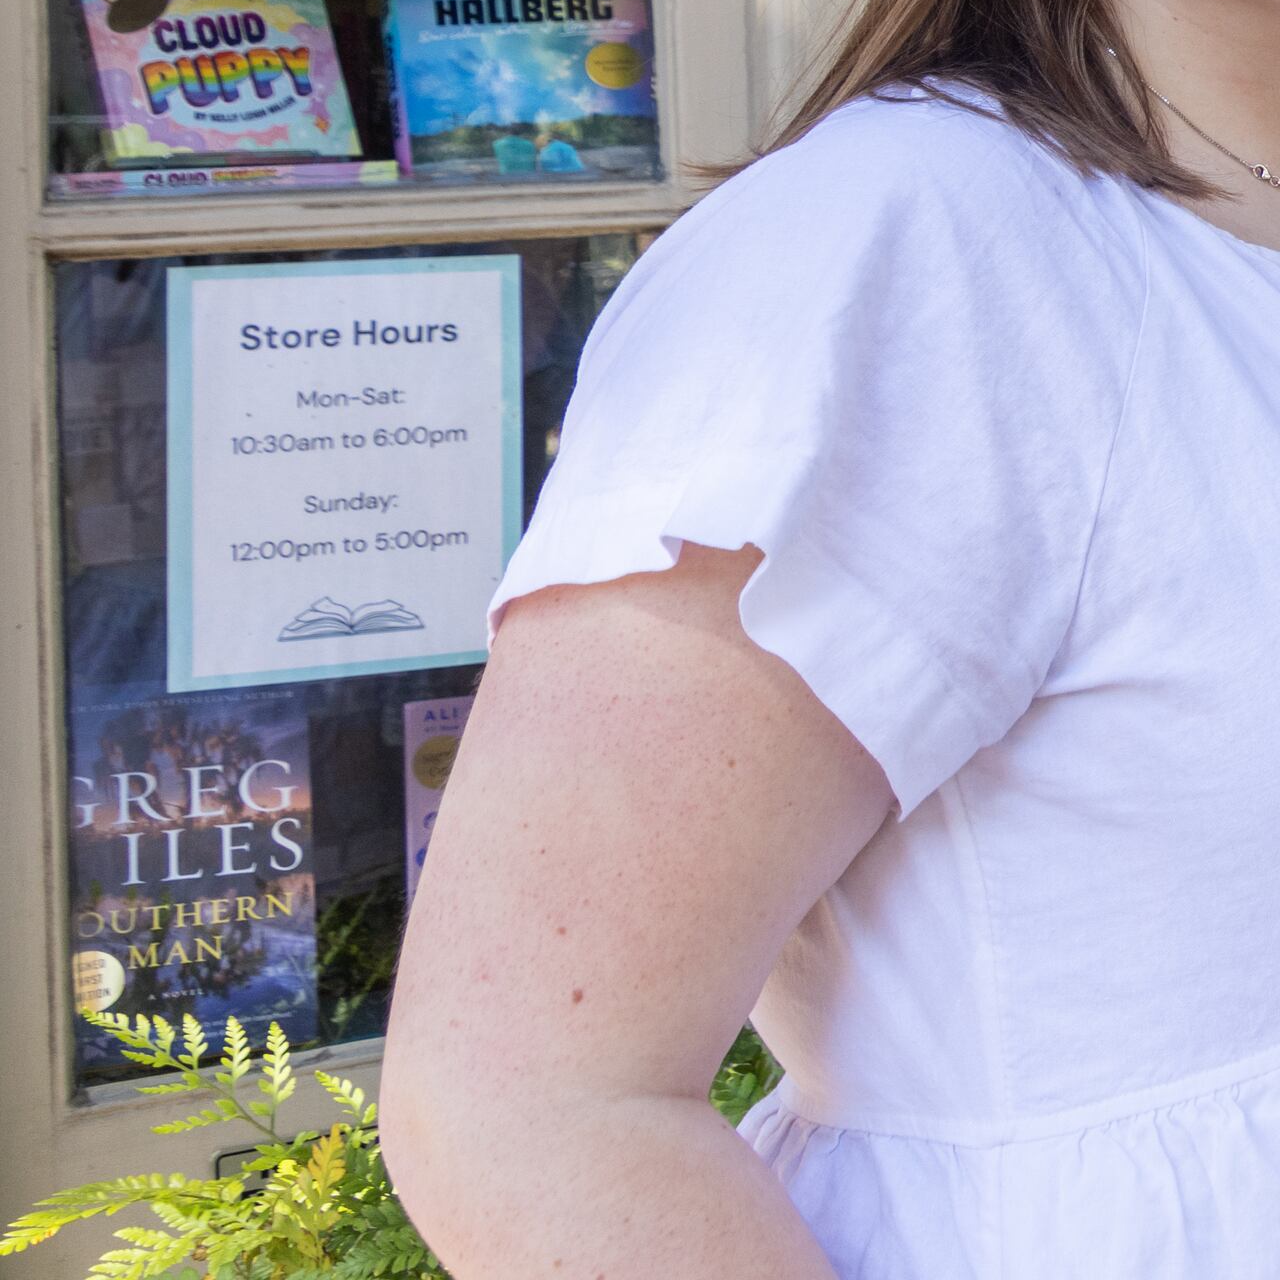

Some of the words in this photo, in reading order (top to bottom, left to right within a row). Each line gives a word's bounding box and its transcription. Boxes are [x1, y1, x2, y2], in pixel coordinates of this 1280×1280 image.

[152, 11, 266, 53] CLOUD
[139, 46, 313, 115] PUPPY
[240, 323, 341, 350] Store
[353, 320, 458, 345] Hours
[296, 387, 406, 408] Mon-Sat:
[231, 433, 335, 455] 10:30am
[342, 432, 367, 449] to
[372, 426, 469, 448] 6:00pm
[303, 492, 399, 514] Sunday:
[230, 539, 335, 562] 12:00pm
[343, 538, 368, 553] to
[375, 529, 469, 551] 5:00pm
[120, 817, 304, 885] ILES
[76, 891, 294, 938] OUTHERN
[128, 935, 224, 969] MAN
